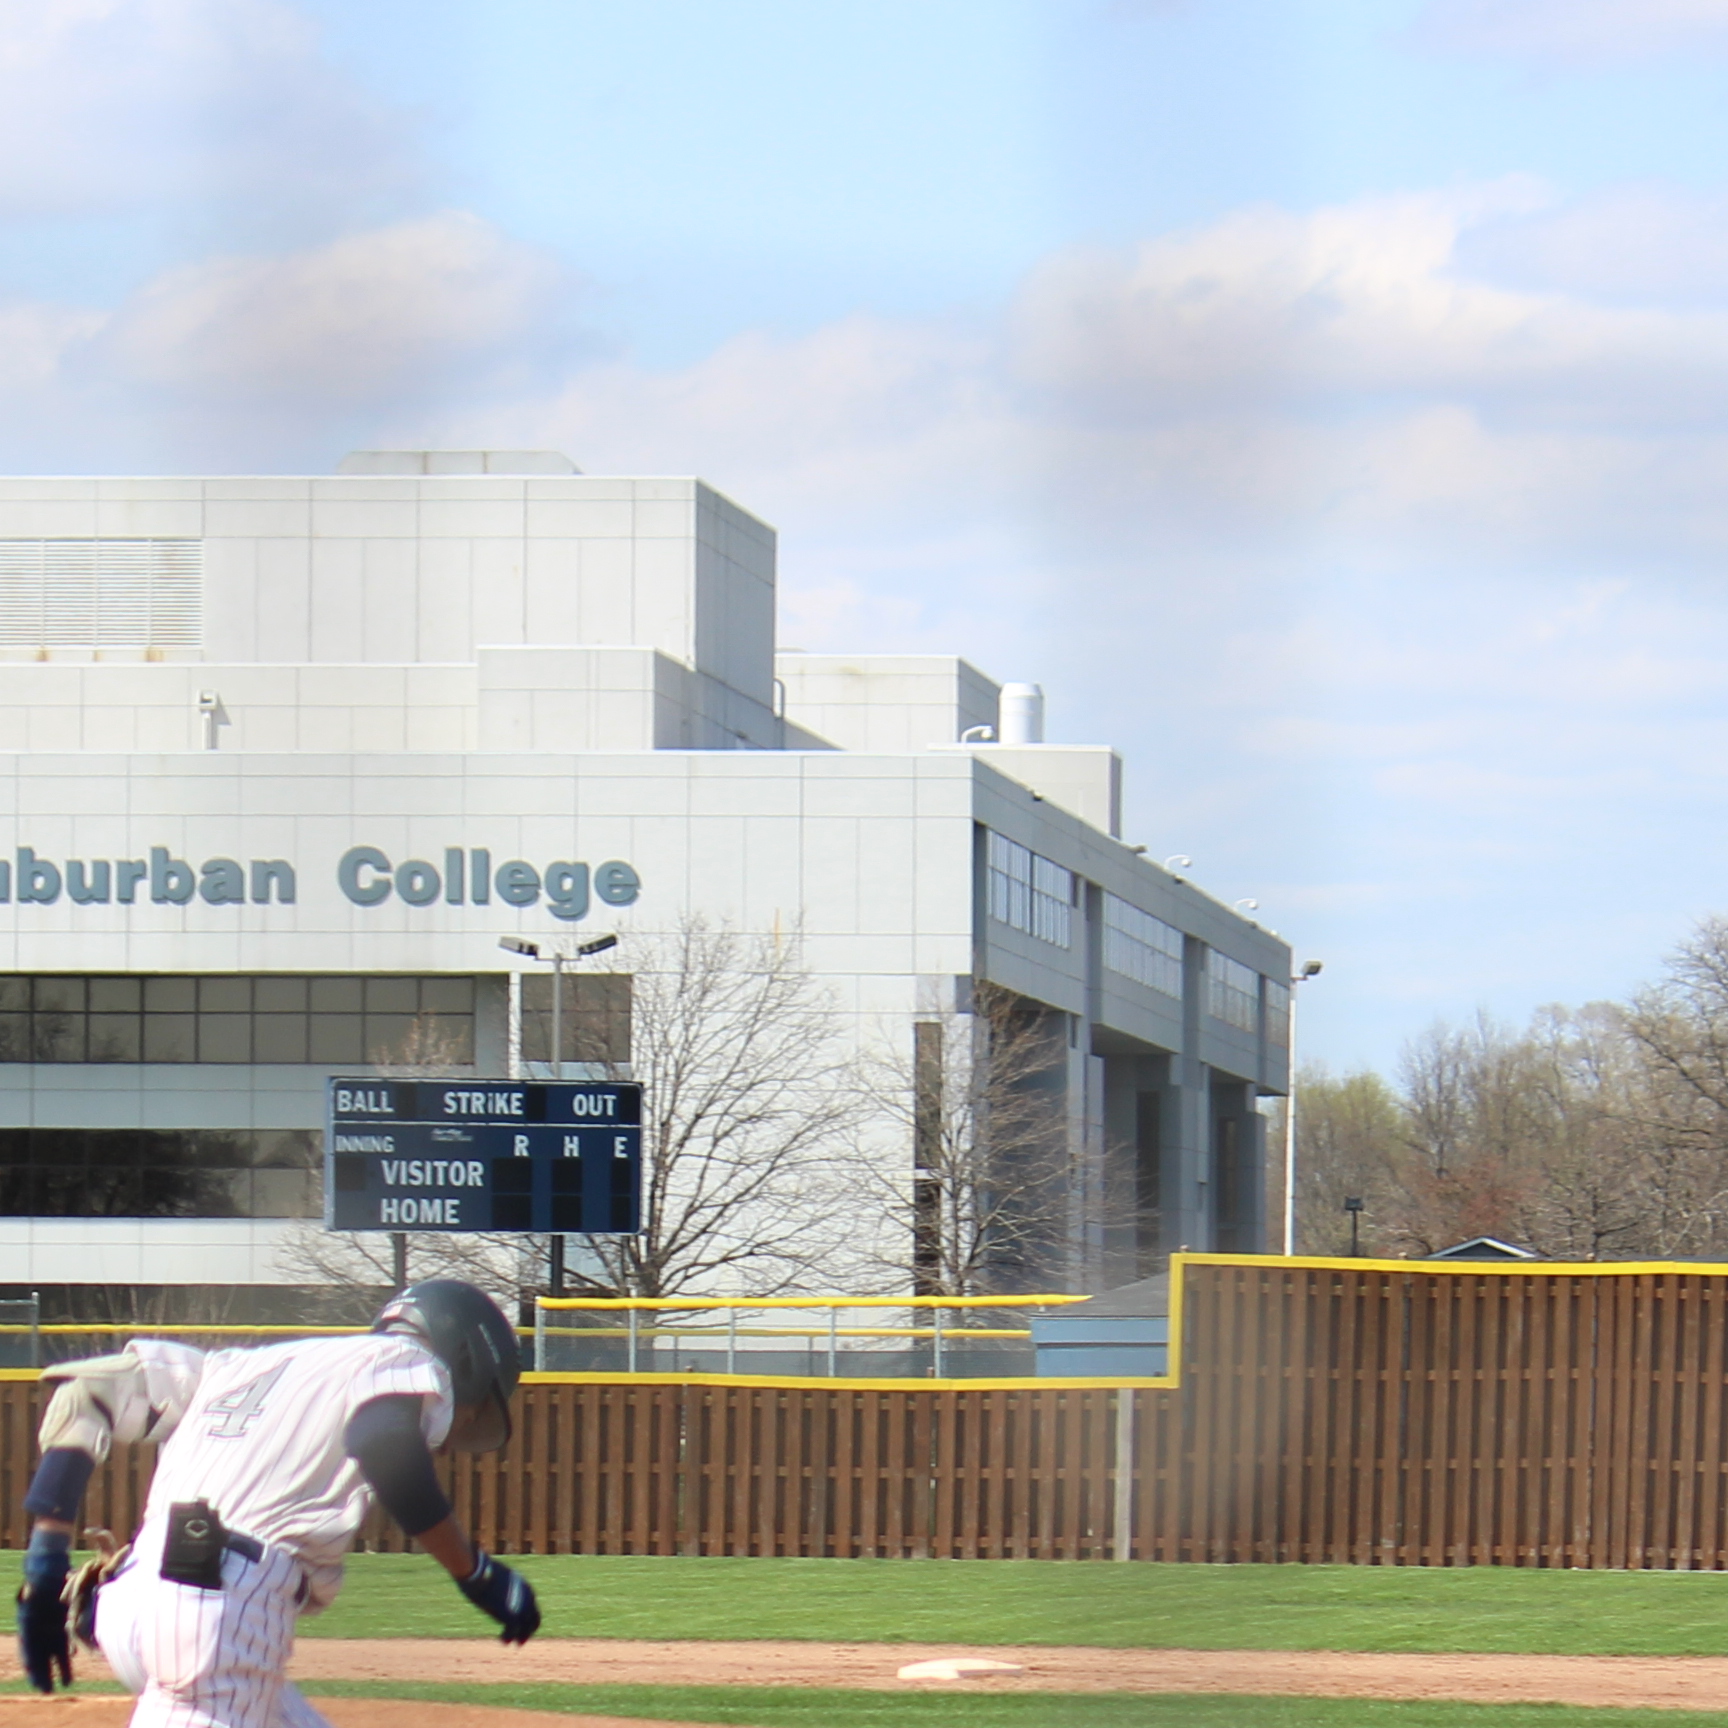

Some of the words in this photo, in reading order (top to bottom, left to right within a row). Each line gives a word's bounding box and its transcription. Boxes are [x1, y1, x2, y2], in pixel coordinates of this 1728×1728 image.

[337, 845, 642, 921] College
[336, 1090, 395, 1113] BALL
[443, 1092, 524, 1115] STRIKE
[572, 1094, 617, 1116] OUT
[335, 1135, 395, 1154] INNING
[514, 1135, 530, 1157] R
[563, 1136, 580, 1158] H
[614, 1136, 628, 1158] E
[380, 1160, 484, 1187] VISITOR
[380, 1198, 460, 1224] HOME
[203, 1356, 295, 1438] 4
